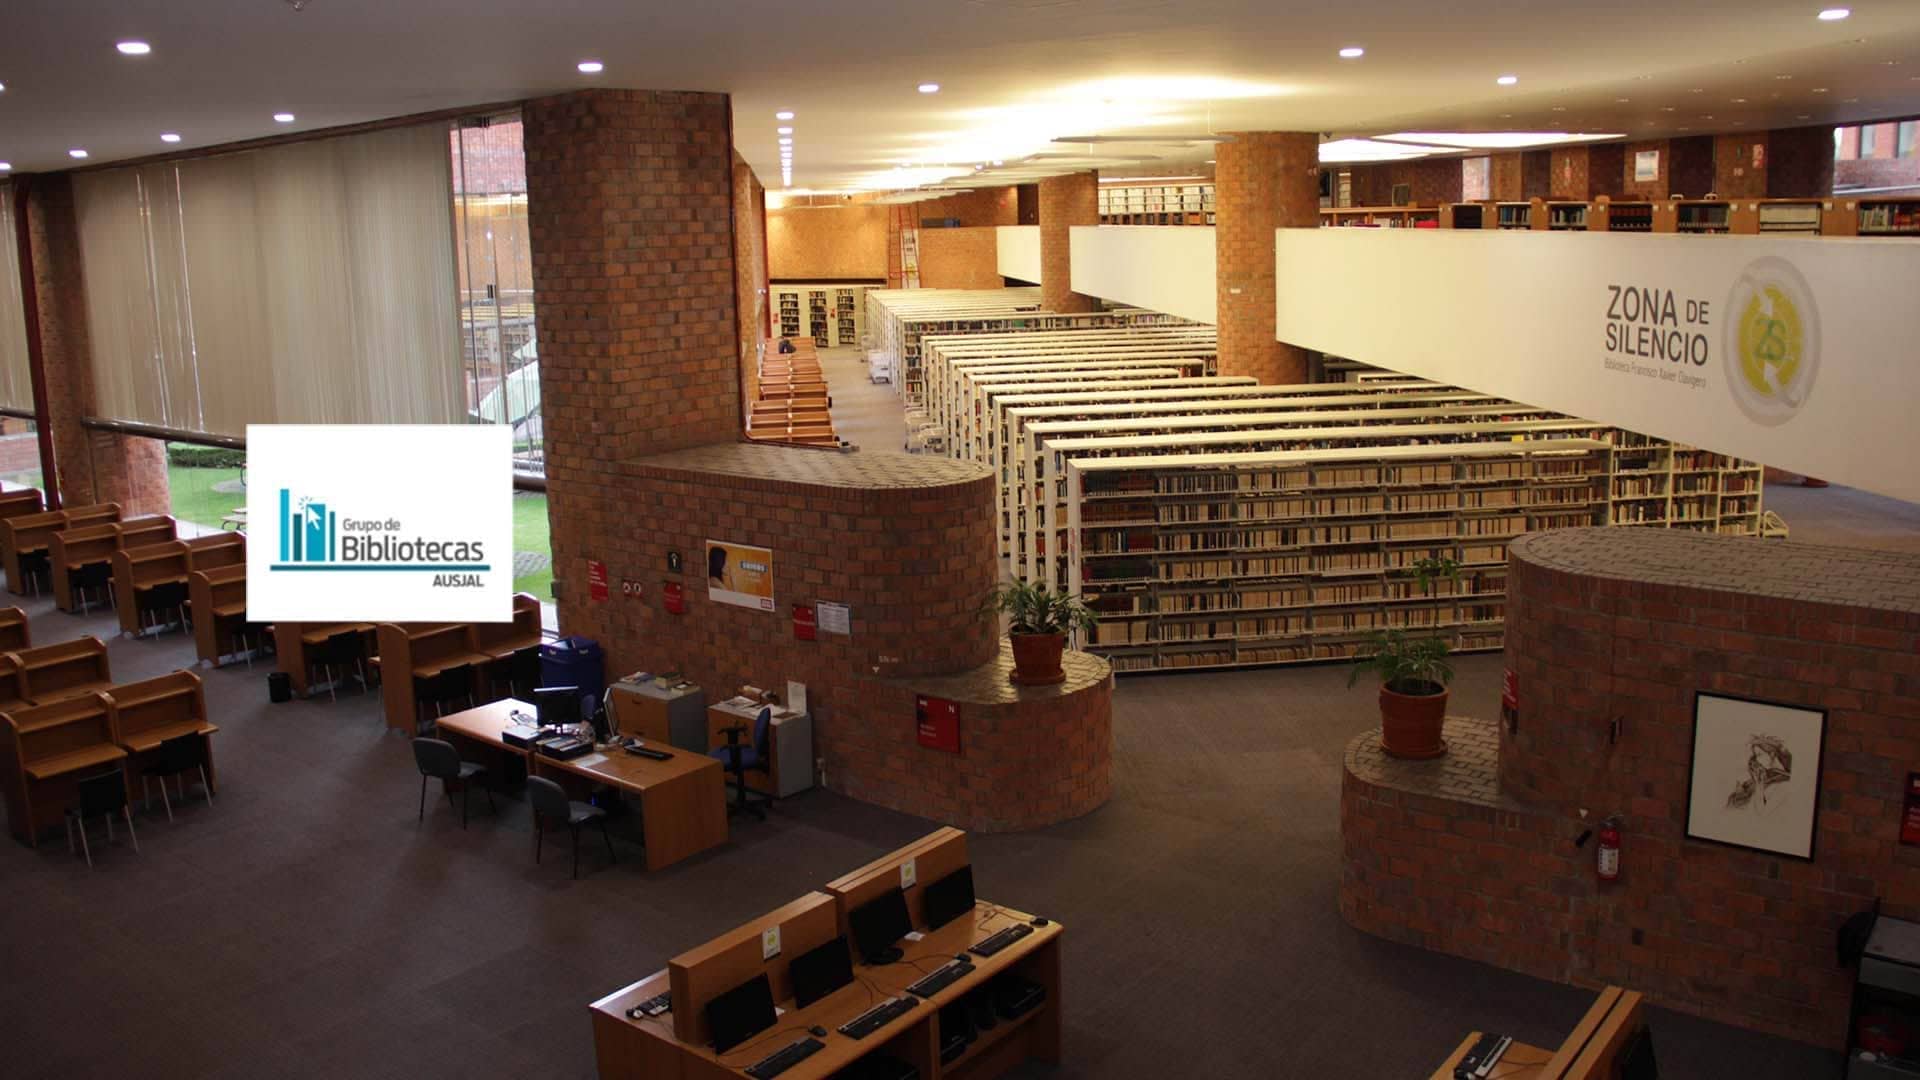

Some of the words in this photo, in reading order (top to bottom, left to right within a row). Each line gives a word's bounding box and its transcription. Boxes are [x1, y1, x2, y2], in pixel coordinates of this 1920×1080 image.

[1607, 285, 1678, 328] ZONA
[1686, 299, 1710, 325] DE
[1606, 322, 1708, 366] SILENCIO
